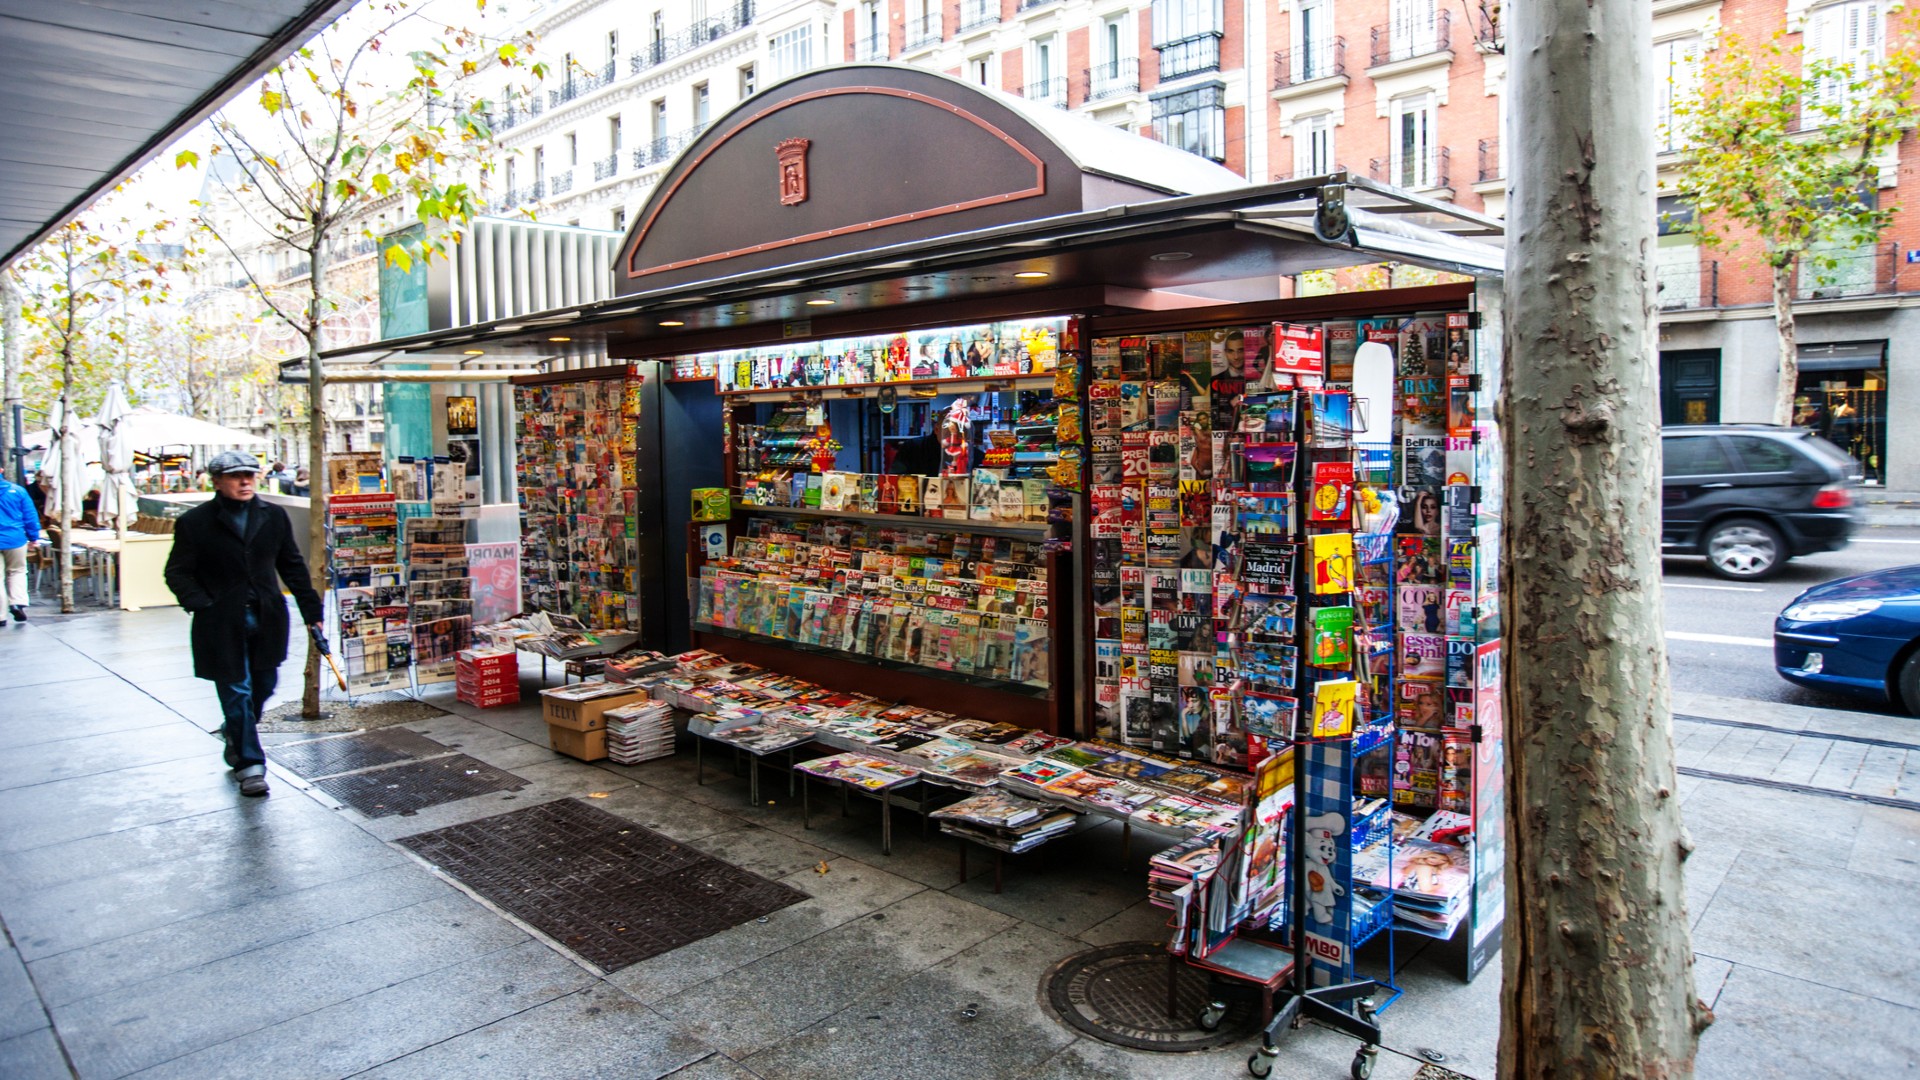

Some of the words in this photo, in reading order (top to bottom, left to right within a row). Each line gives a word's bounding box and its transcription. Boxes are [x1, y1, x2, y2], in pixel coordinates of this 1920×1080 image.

[1149, 431, 1178, 446] foto
[1328, 466, 1351, 474] PAELLA
[1148, 486, 1177, 498] Photo
[1147, 535, 1176, 546] Digital
[1246, 561, 1285, 573] Madrid
[481, 658, 499, 666] 2014
[482, 668, 501, 676] 2014
[1150, 665, 1176, 675] BEST
[482, 677, 501, 686] 2014
[483, 687, 502, 696] 2014
[484, 698, 502, 706] 2014
[1153, 693, 1172, 703] Black
[550, 704, 577, 722] TELVA
